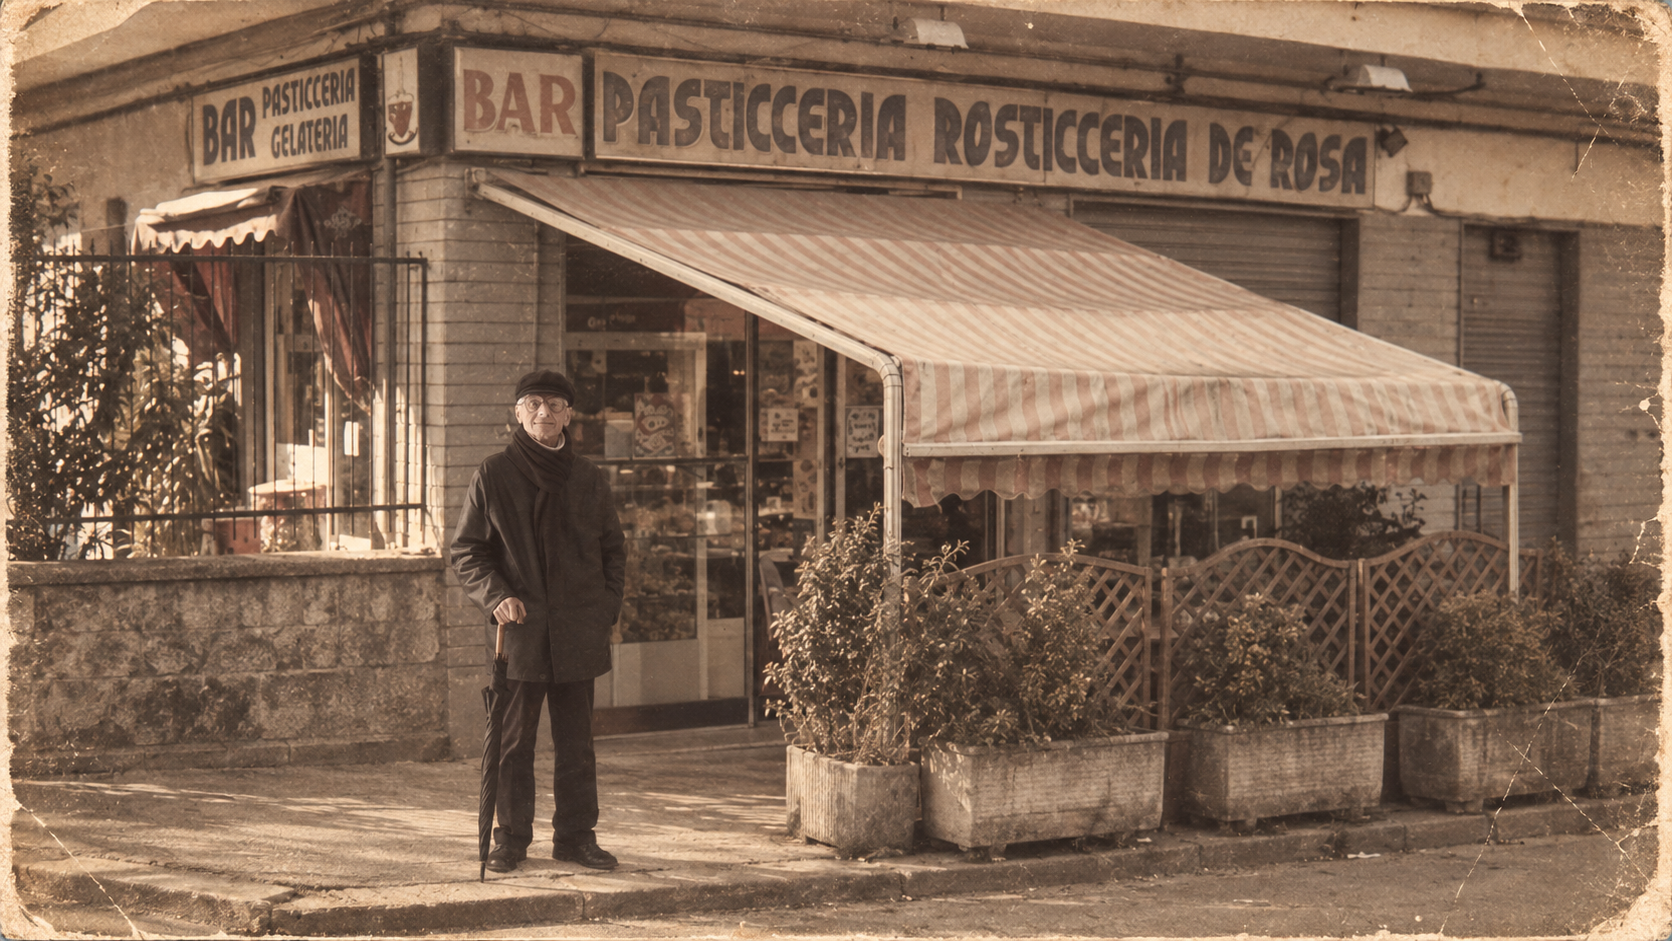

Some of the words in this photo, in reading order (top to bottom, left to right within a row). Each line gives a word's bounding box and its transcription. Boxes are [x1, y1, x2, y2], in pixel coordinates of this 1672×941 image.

[261, 67, 355, 119] PASTICCERIA
[463, 68, 578, 136] BAR
[202, 95, 257, 166] BAR
[270, 113, 349, 159] GELATERIA
[602, 70, 907, 162] PASTICCERIA
[933, 96, 1188, 183] ROSTICCERIA
[1208, 122, 1254, 187] DE
[1270, 127, 1367, 195] ROSA
